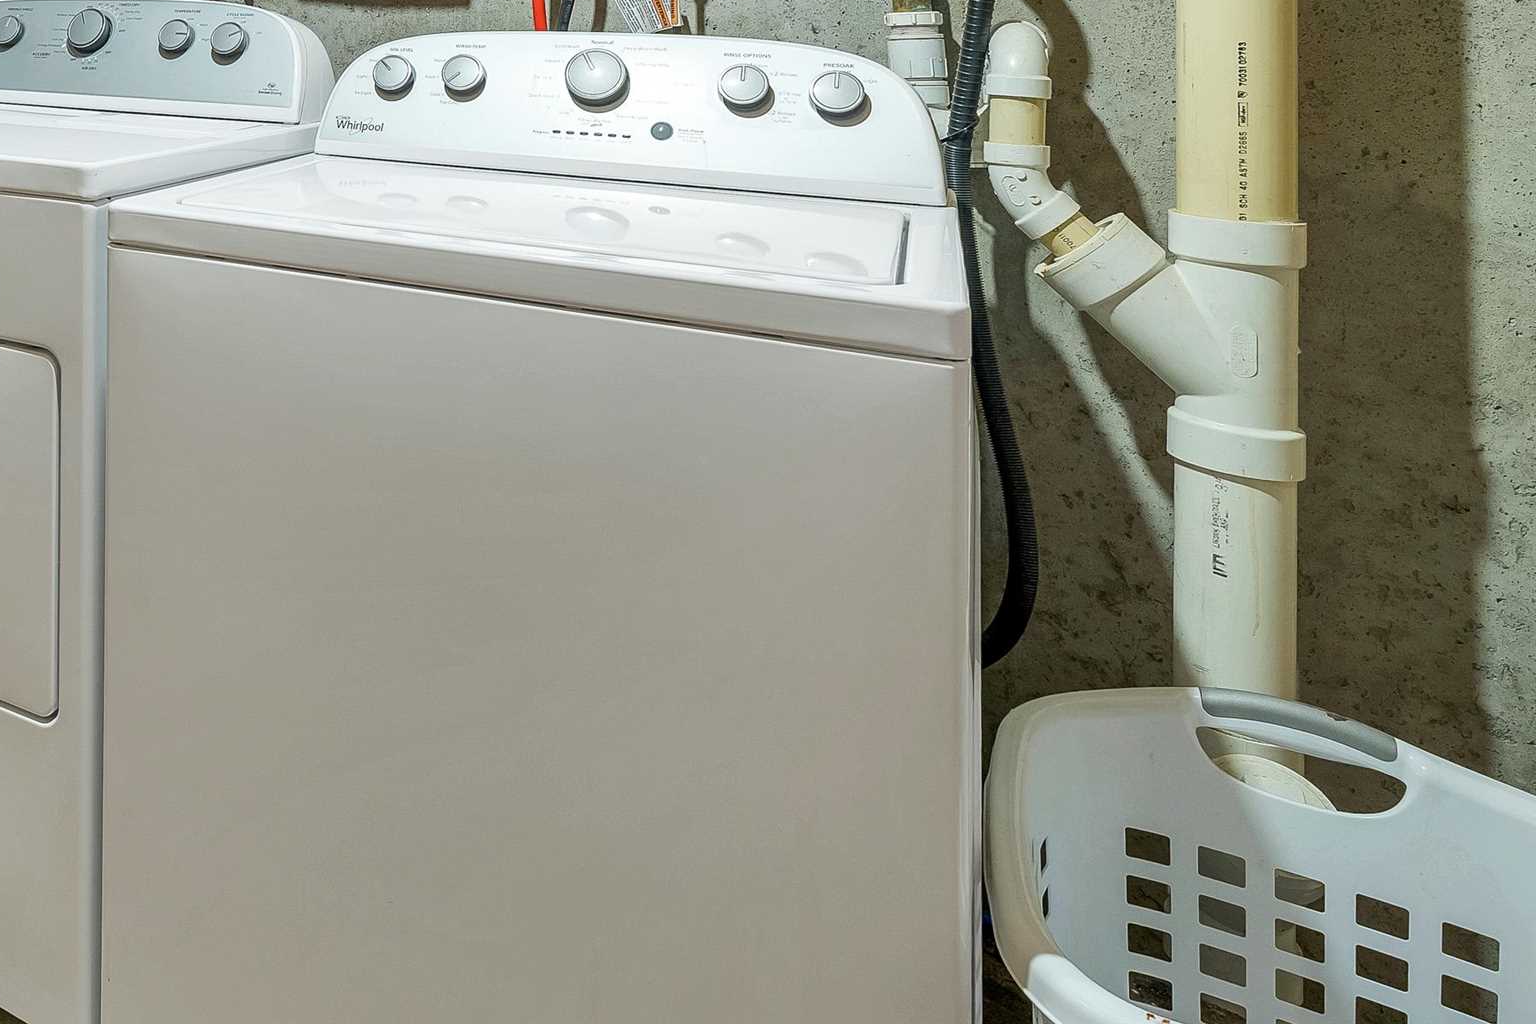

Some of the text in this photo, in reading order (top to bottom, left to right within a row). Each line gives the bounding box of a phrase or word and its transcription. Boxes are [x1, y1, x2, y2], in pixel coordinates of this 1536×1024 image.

[336, 119, 384, 132] Whirlpool
[1239, 158, 1247, 178] ASTM
[1239, 180, 1247, 191] 40
[1239, 193, 1247, 209] SCH
